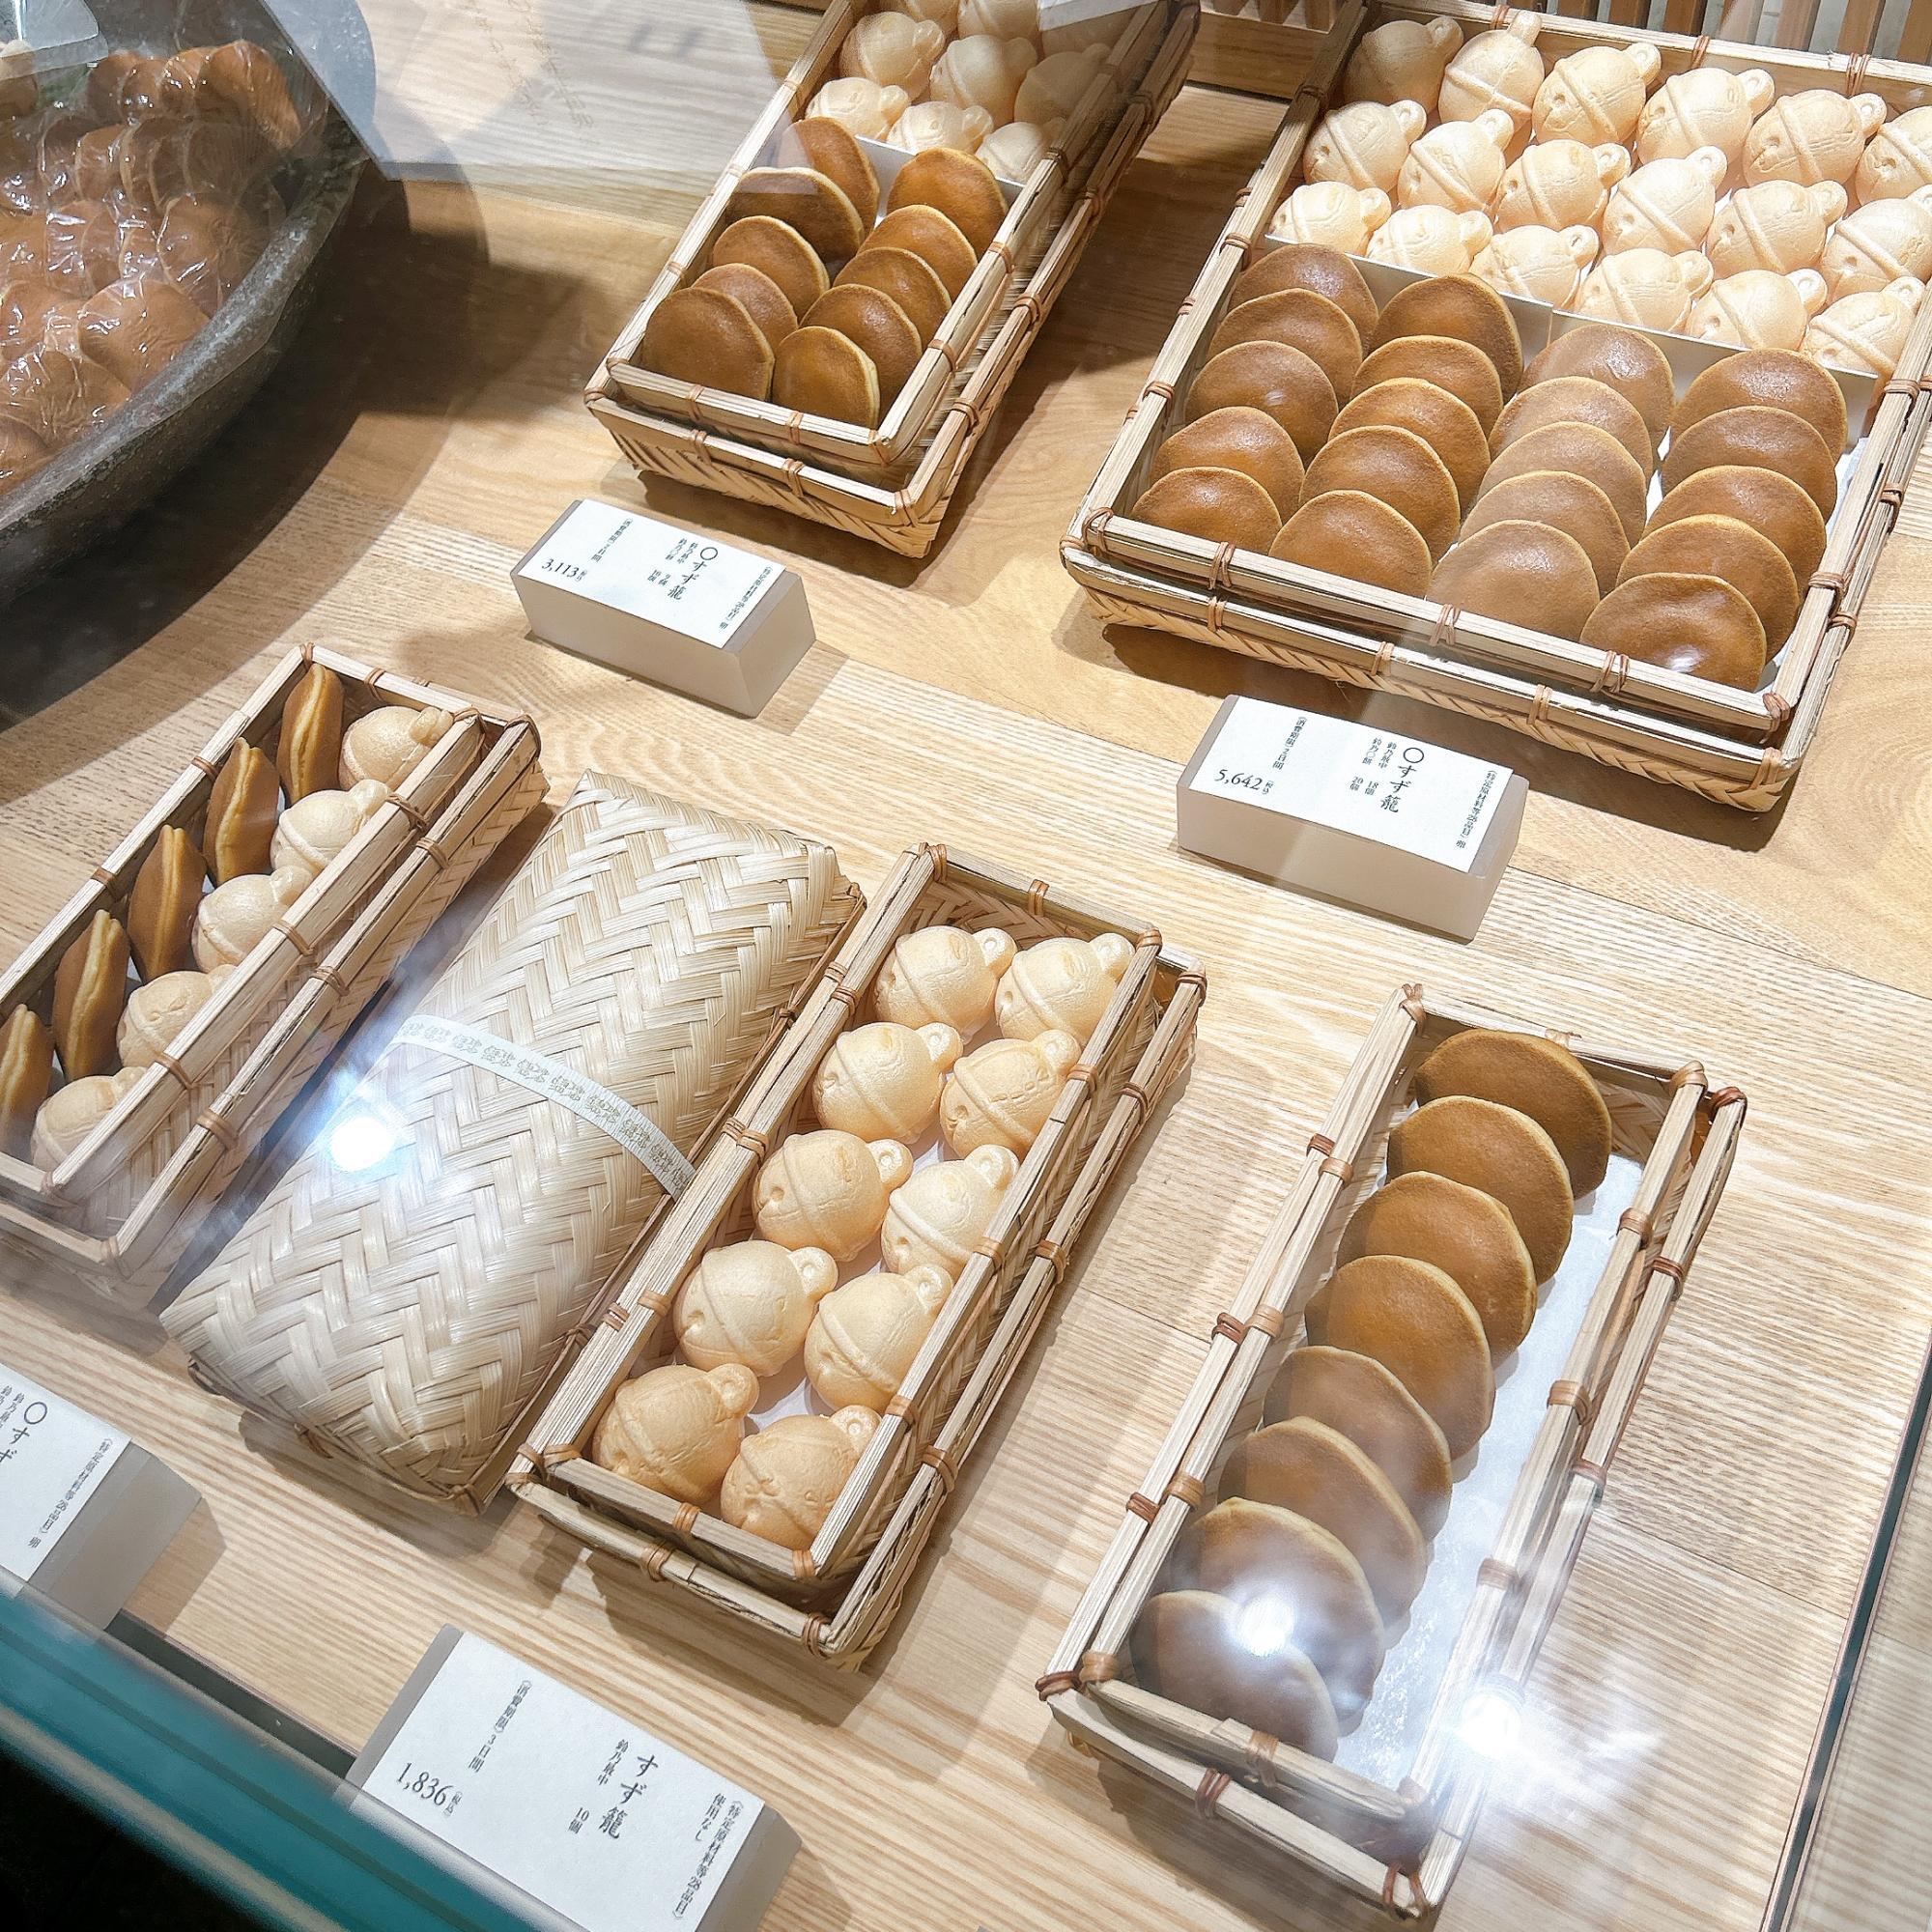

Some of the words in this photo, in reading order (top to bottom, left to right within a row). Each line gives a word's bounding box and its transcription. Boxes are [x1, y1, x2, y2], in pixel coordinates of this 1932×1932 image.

[541, 558, 580, 578] 3,113
[1214, 768, 1263, 790] 5,642
[396, 1762, 454, 1806] 1,836
[597, 1739, 629, 1786] 鈴乃最中
[598, 1755, 659, 1839] すず籠
[695, 1793, 727, 1842] 使用なし
[567, 1806, 590, 1834] 10個
